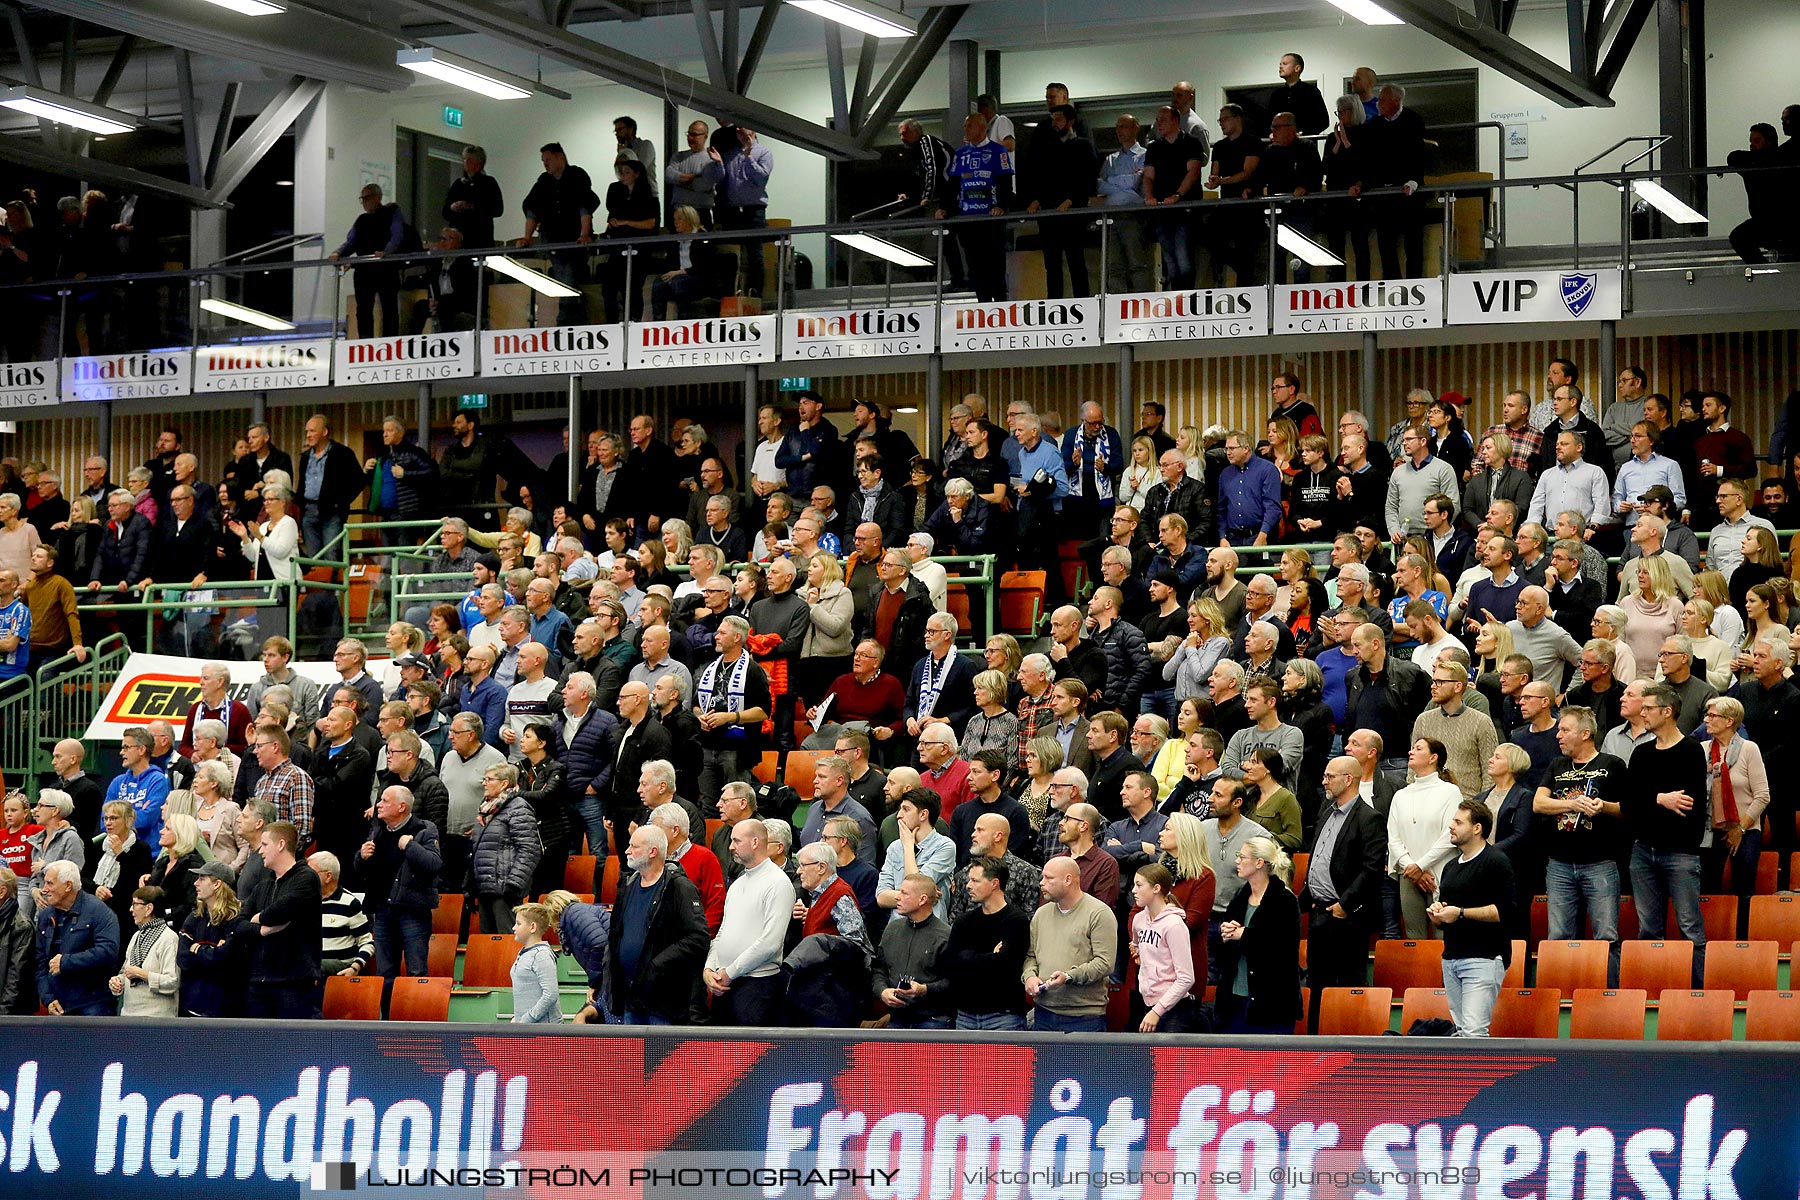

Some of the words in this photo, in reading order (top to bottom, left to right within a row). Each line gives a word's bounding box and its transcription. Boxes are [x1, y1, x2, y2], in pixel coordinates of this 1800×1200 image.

[1564, 280, 1579, 288] IFK
[1119, 289, 1253, 320] mattias
[1289, 280, 1427, 311] mattias
[1472, 279, 1539, 313] VIP
[796, 308, 921, 338] mattias
[955, 300, 1085, 330] mattias
[1300, 314, 1416, 333] CATERING
[493, 326, 610, 355] mattias
[641, 318, 762, 347] mattias
[966, 332, 1075, 351] CATERING
[1130, 322, 1242, 341] CATERING
[208, 344, 318, 371] mattias
[348, 334, 461, 364] mattias
[651, 349, 752, 368] CATERING
[806, 341, 911, 359] CATERING
[73, 353, 179, 381] mattias
[357, 364, 452, 384] CATERING
[503, 358, 601, 376] CATERING
[83, 383, 170, 400] CATERING
[216, 373, 308, 391] CATERING
[1, 845, 26, 855] coop
[1138, 929, 1162, 949] GANT
[94, 1061, 528, 1188] handboll!
[762, 1078, 1147, 1200] Framåt
[1166, 1084, 1341, 1200] för
[1354, 1093, 1749, 1200] svensk
